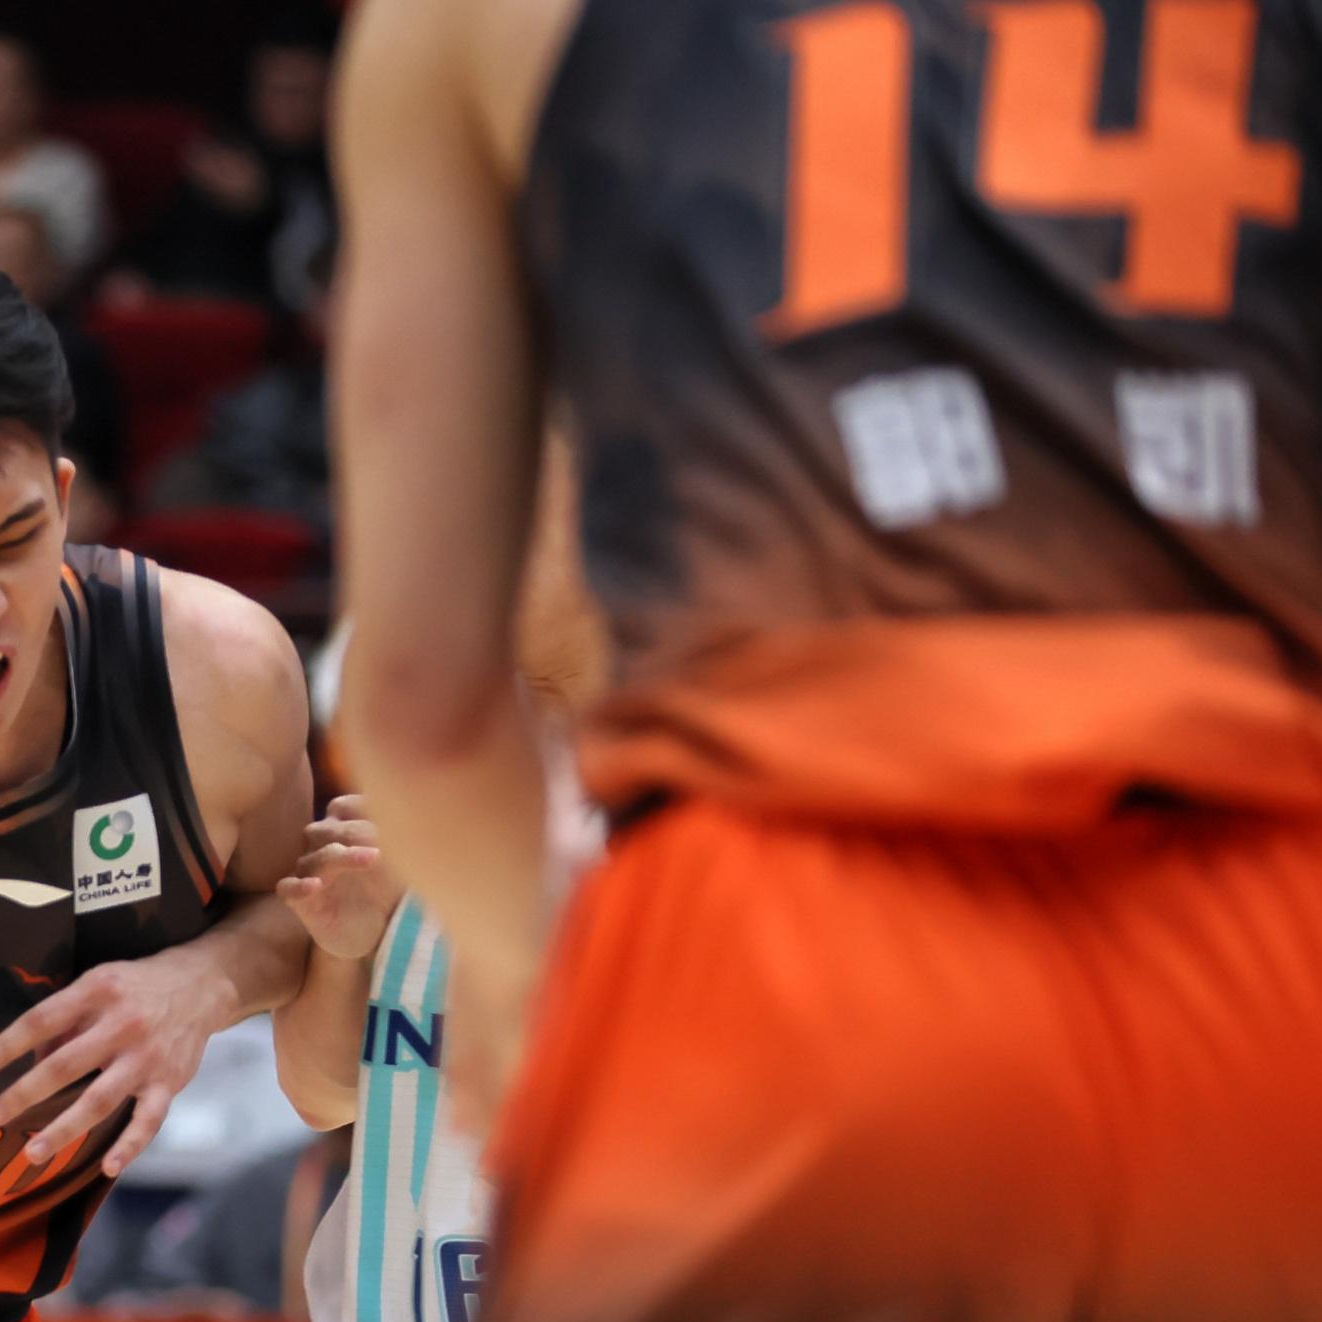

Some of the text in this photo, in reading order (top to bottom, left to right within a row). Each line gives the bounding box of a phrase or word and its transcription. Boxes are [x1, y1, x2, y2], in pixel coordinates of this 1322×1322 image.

[758, 0, 1303, 345] 14
[77, 863, 152, 890] 中国人寿
[78, 880, 151, 902] CHINA LIFE
